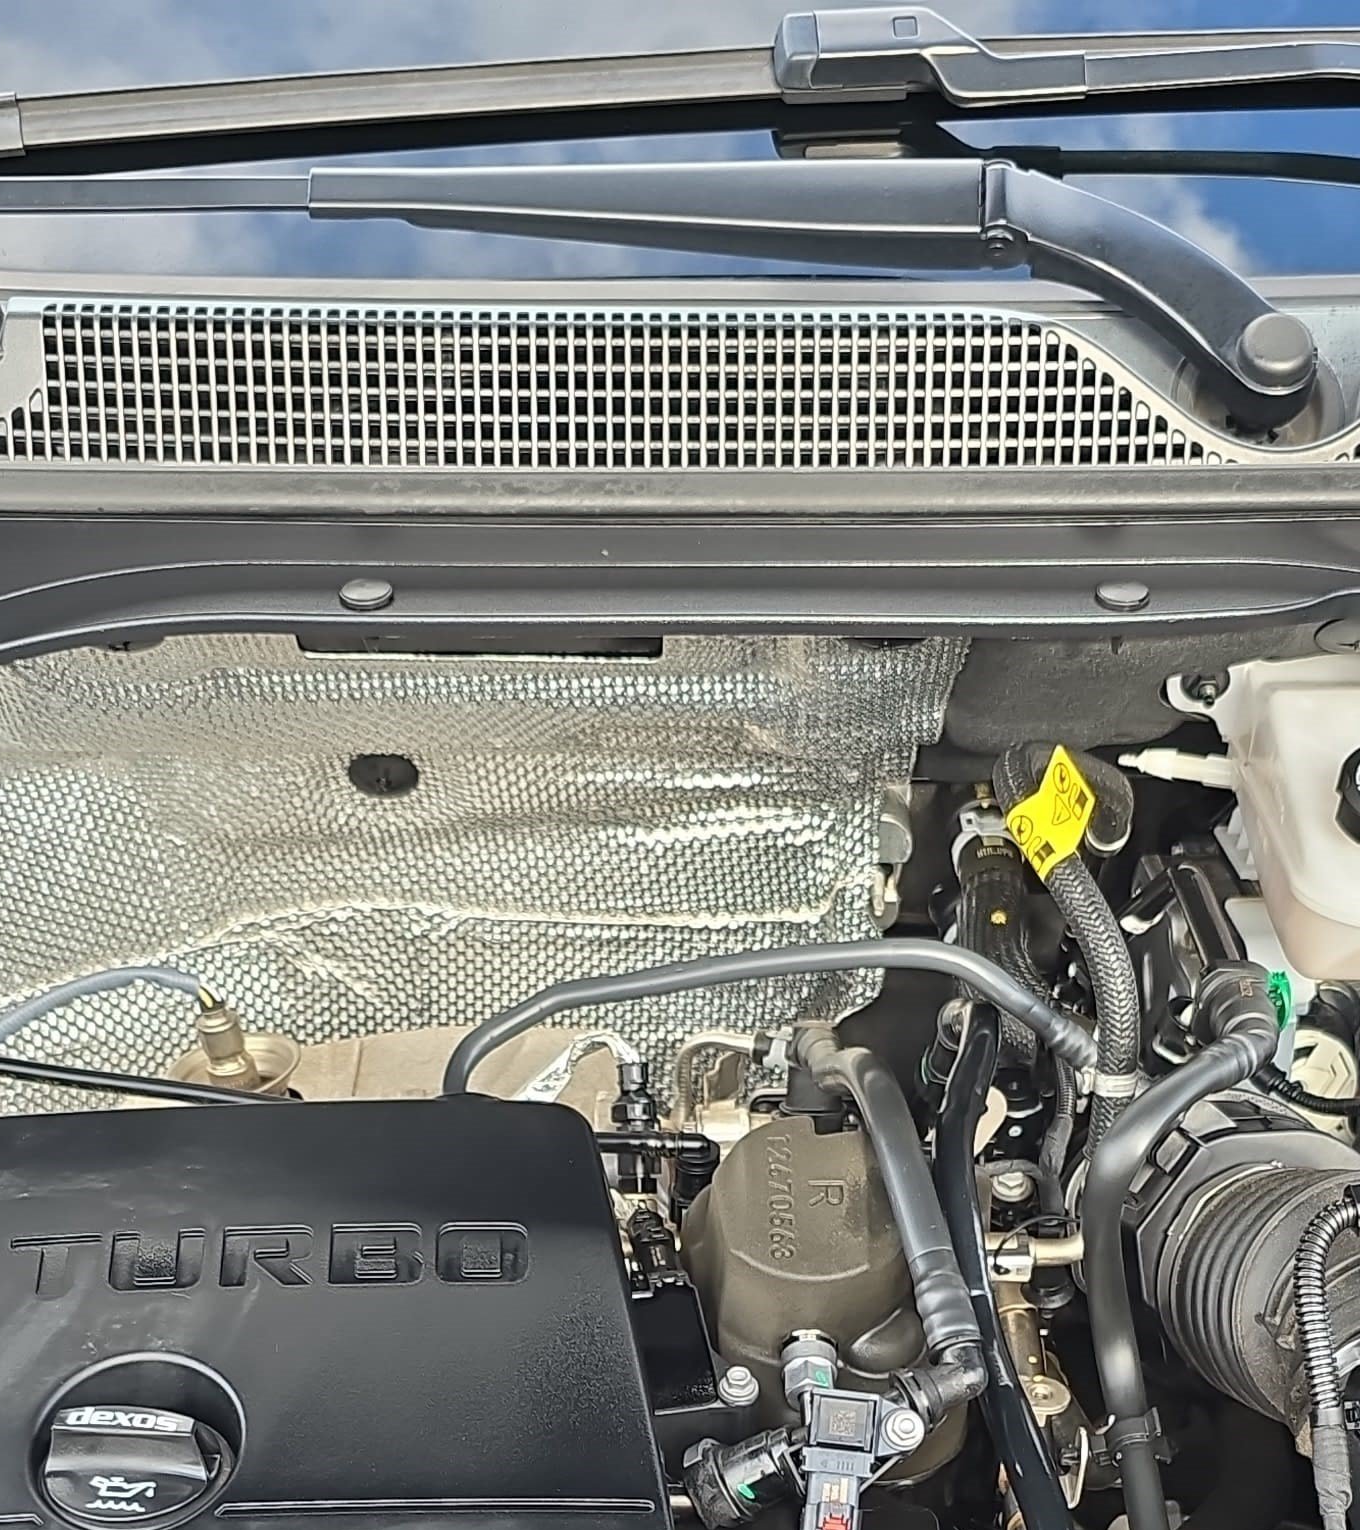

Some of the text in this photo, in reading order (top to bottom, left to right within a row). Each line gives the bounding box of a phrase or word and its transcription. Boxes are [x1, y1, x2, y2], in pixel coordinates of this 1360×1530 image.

[807, 1179, 848, 1207] R
[10, 1221, 530, 1296] TURBO
[66, 1407, 177, 1431] dexos
